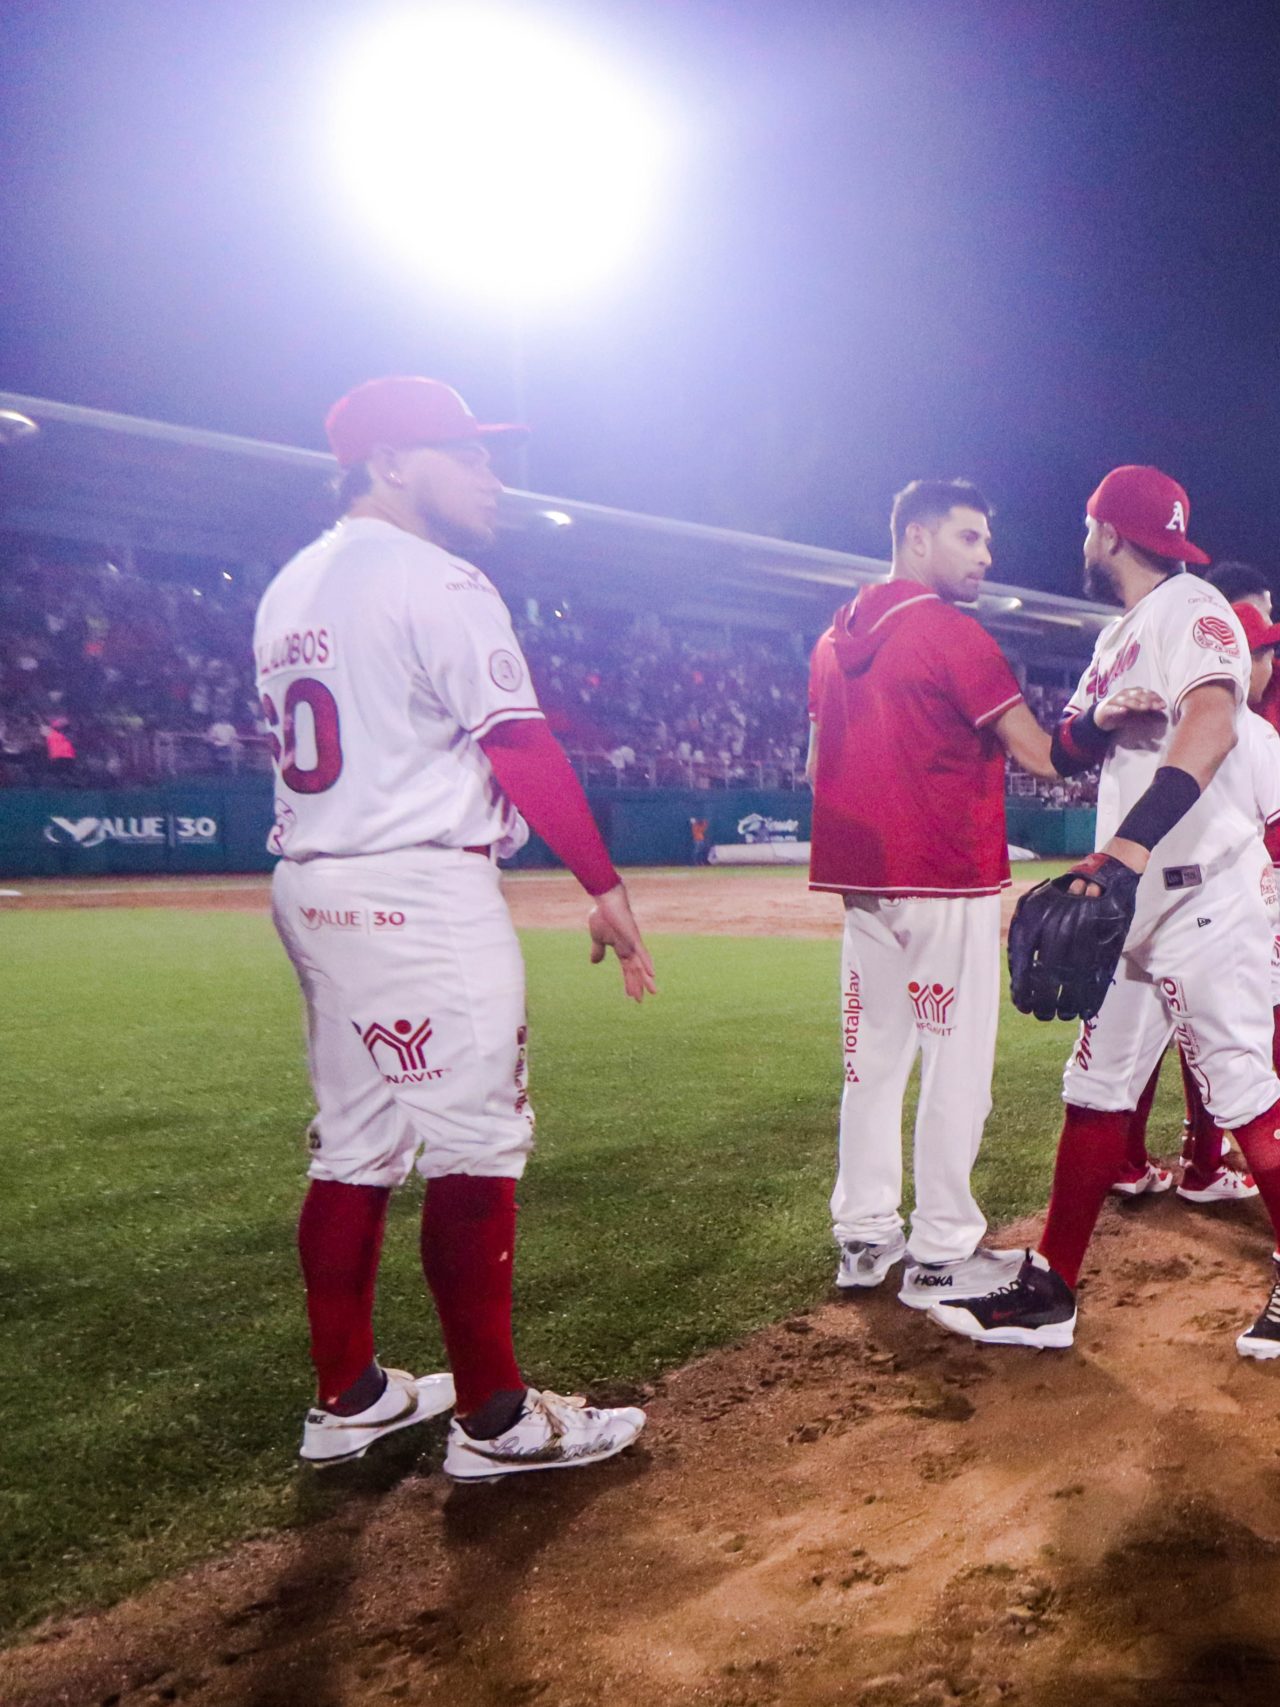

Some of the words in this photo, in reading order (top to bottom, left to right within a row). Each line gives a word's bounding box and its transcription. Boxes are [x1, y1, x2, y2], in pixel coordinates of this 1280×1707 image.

[1165, 500, 1185, 532] A
[45, 816, 166, 848] VALUE
[176, 817, 217, 838] 30
[373, 910, 406, 926] 30
[844, 969, 864, 1054] Totalplay
[914, 1274, 953, 1287] HOKA
